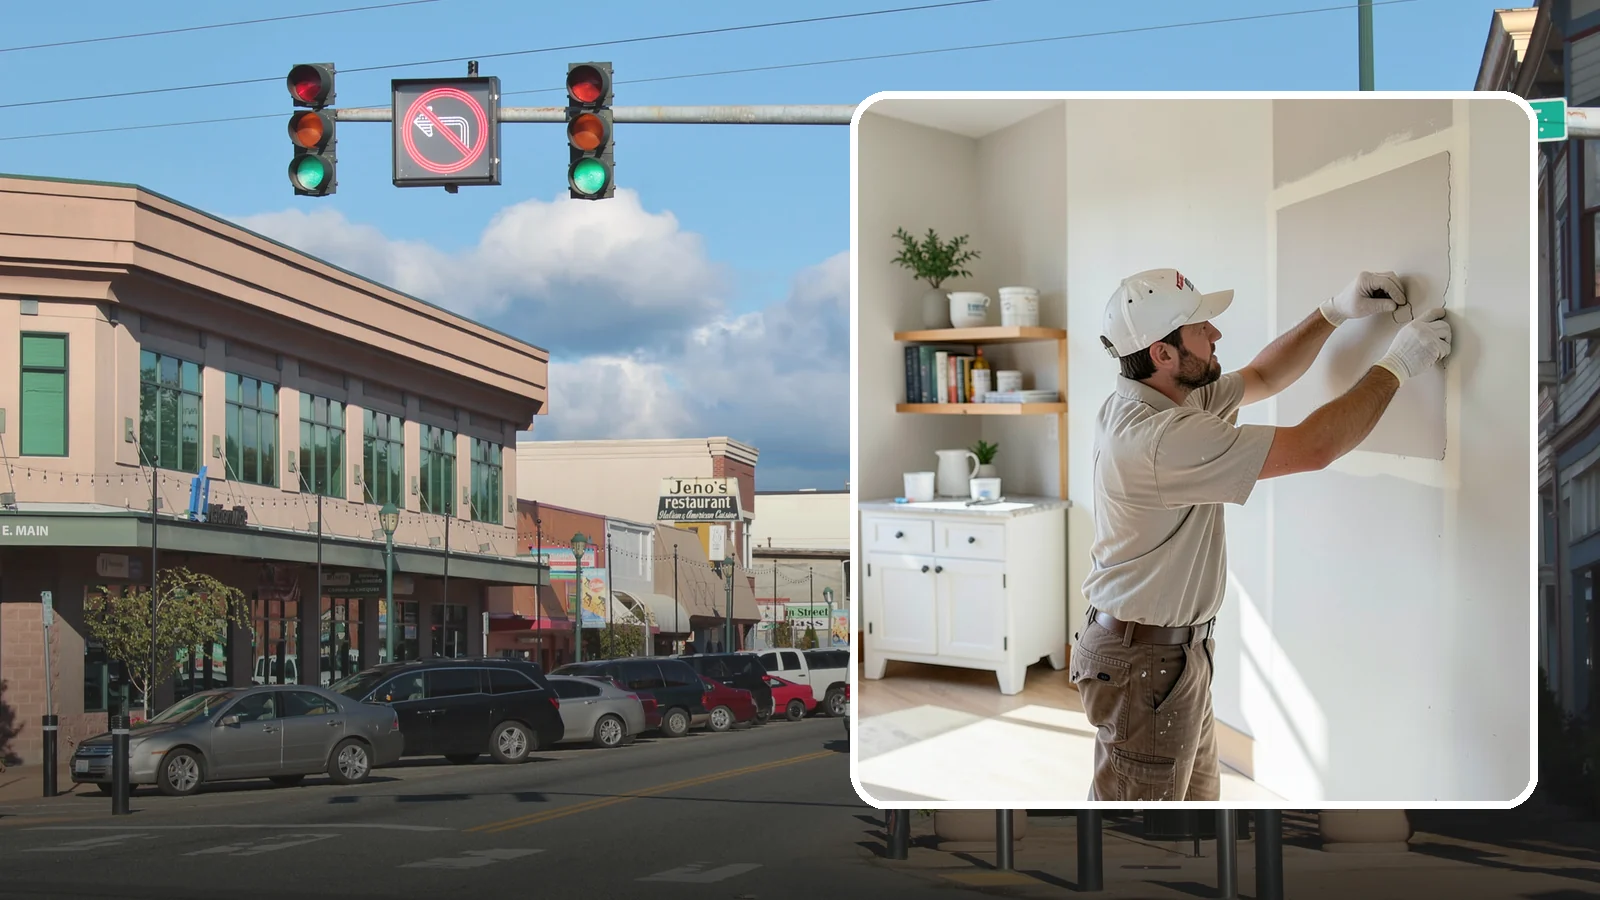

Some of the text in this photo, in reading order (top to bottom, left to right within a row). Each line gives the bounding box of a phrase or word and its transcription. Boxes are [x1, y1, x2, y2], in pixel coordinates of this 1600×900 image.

[669, 480, 728, 495] Jeno's
[665, 496, 731, 509] restaurant
[658, 510, 682, 519] Italian
[686, 509, 714, 519] American
[715, 509, 737, 519] Cuisine
[2, 525, 49, 536] E. MAIN
[798, 607, 828, 616] Street
